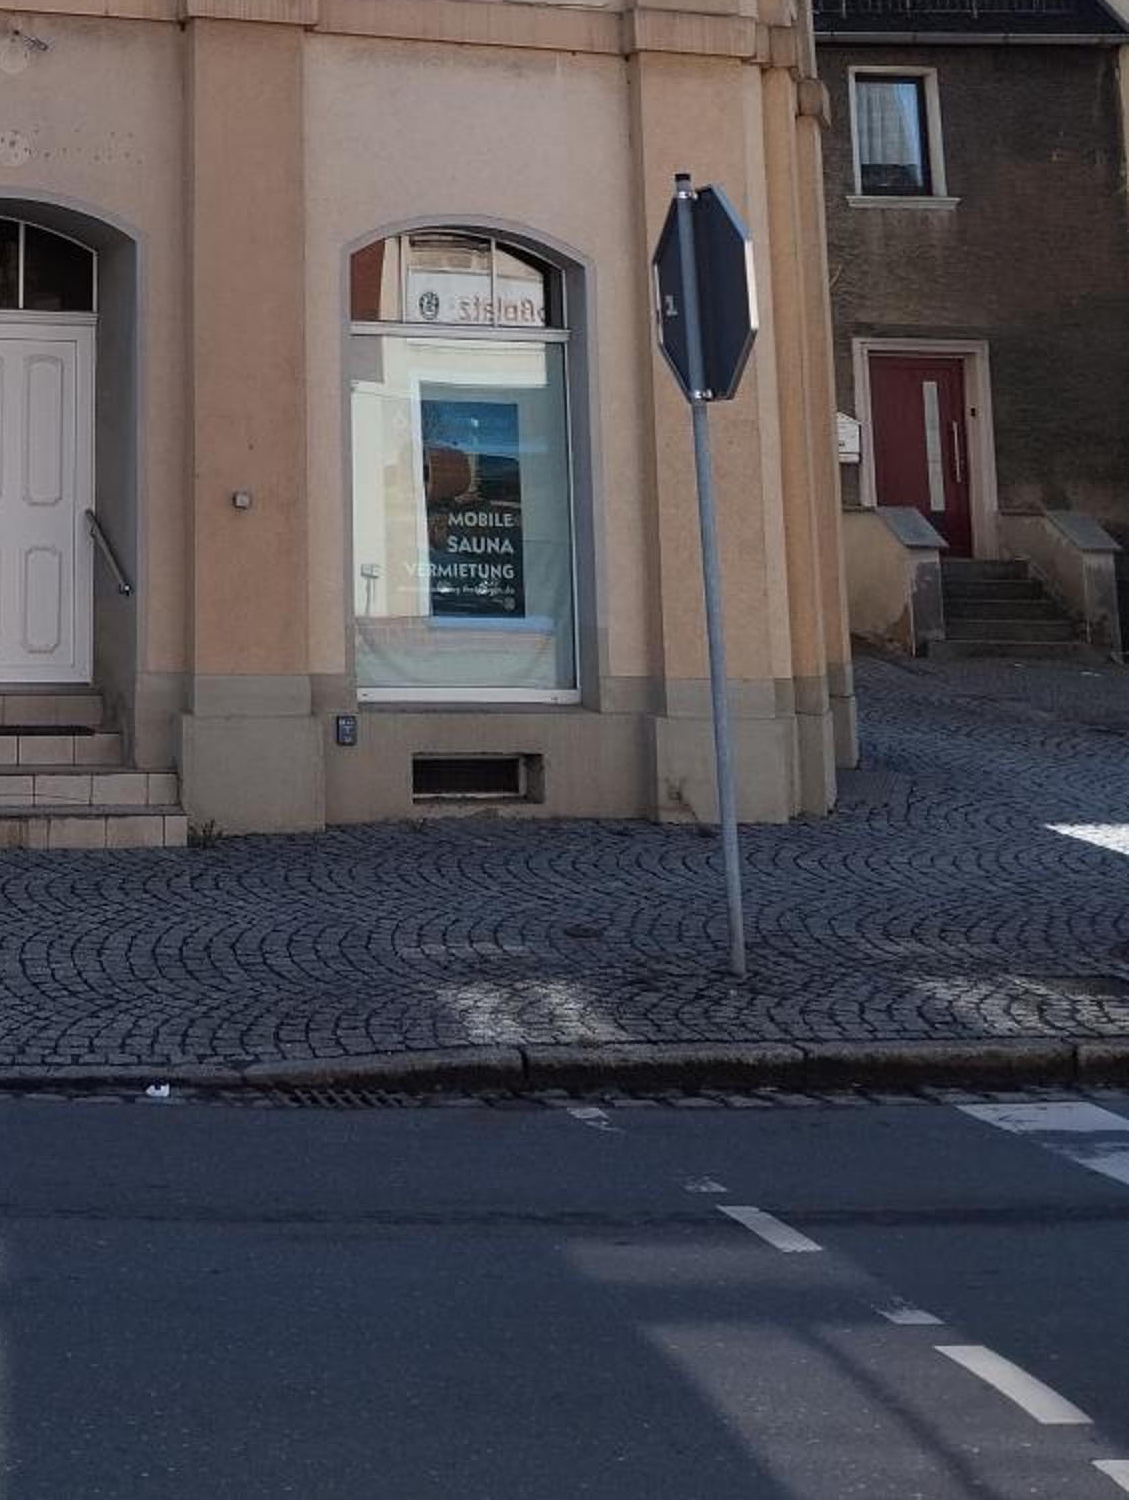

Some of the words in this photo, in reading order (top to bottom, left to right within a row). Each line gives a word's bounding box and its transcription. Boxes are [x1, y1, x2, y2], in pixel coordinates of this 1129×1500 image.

[448, 511, 514, 527] MOBILE
[448, 535, 514, 554] SAUNA
[406, 563, 515, 579] VERMIETUNG
